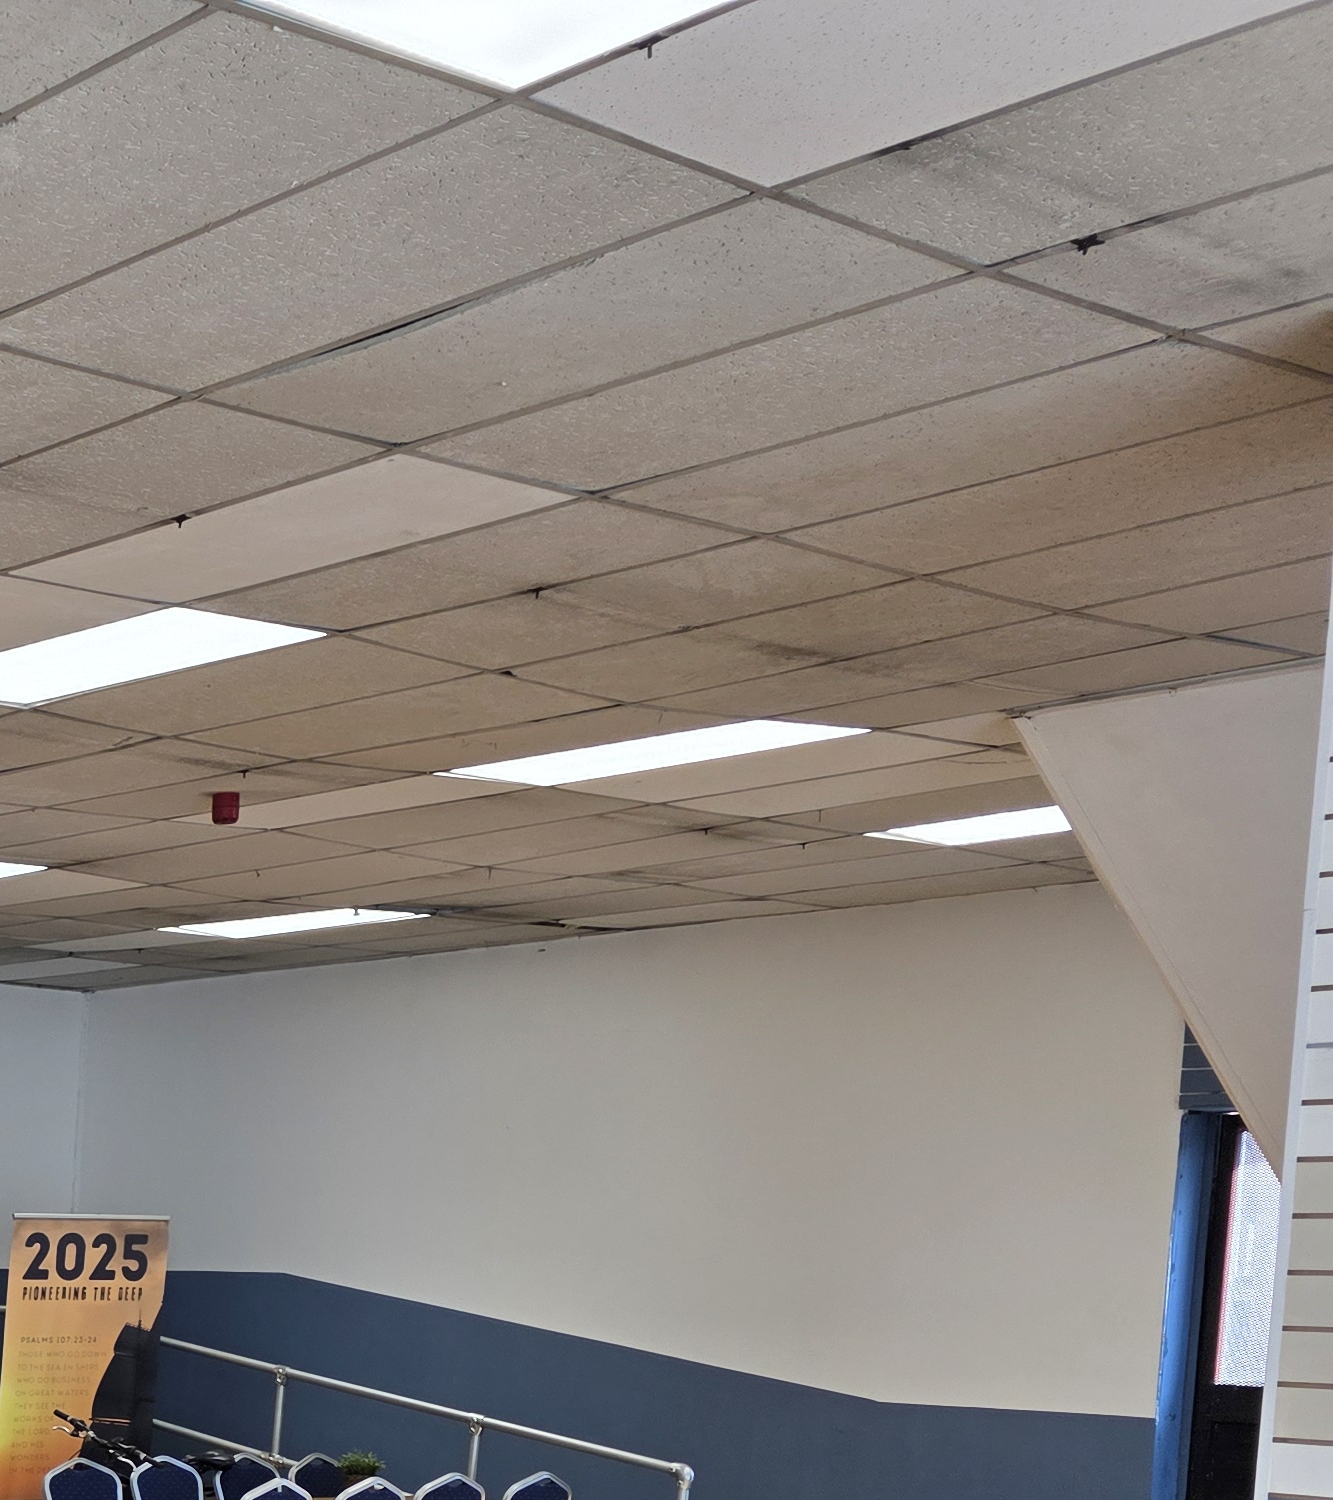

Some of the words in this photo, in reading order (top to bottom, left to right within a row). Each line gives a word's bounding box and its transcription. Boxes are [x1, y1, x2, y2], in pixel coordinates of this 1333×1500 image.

[22, 1232, 148, 1281] 2025
[22, 1286, 87, 1300] PIONEERING
[94, 1287, 111, 1301] THE
[118, 1287, 143, 1301] DEEP
